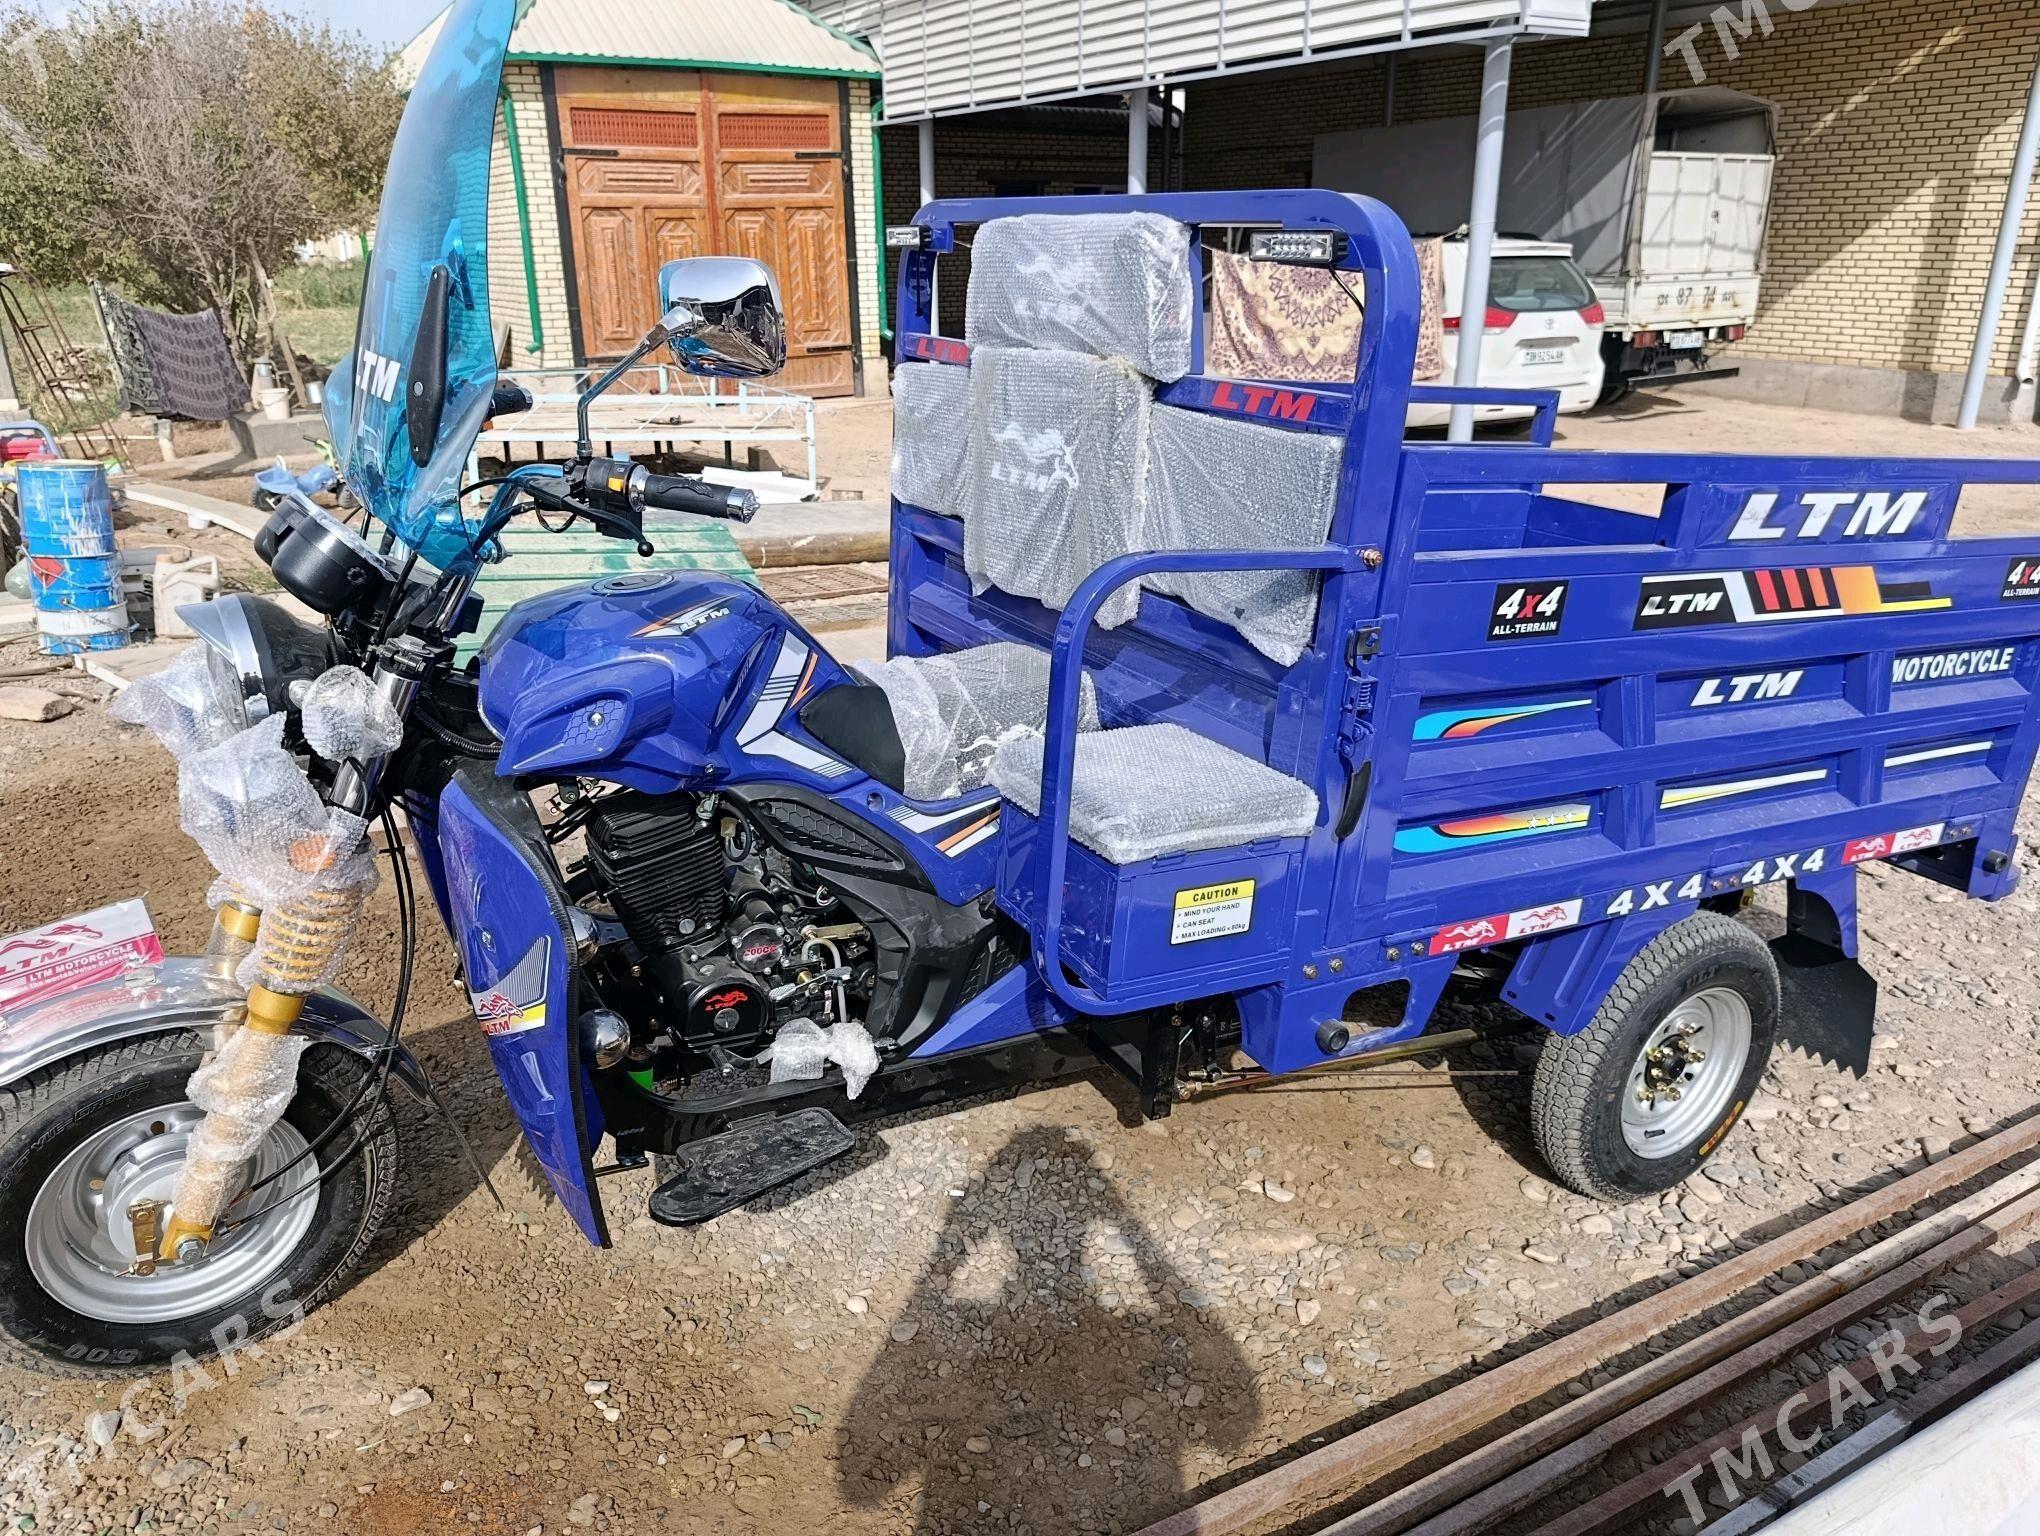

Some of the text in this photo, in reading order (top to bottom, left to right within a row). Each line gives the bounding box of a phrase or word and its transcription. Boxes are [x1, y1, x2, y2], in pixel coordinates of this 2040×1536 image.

[1211, 381, 1317, 421] LTM
[1727, 492, 1928, 540] LTM
[2002, 587, 2040, 598] ALL-TERRAIN
[1640, 591, 1724, 617] LTM
[678, 606, 731, 633] LTM
[1492, 620, 1558, 636] ALL-TERRAIN
[1892, 647, 2015, 683] MOTORCYCLE
[1690, 670, 1804, 707] LTM
[1193, 887, 1239, 902] CAUTION
[1202, 905, 1221, 914] YOUR
[1221, 902, 1240, 911] HAND
[1182, 917, 1215, 929] CAN SEAT
[1519, 921, 1550, 934] LTM
[1181, 931, 1196, 939] MAX
[1197, 926, 1226, 937] LOADING
[1441, 934, 1479, 952] LTM
[30, 943, 134, 982] LTM MOTORCYCLE
[487, 1020, 511, 1035] LTM
